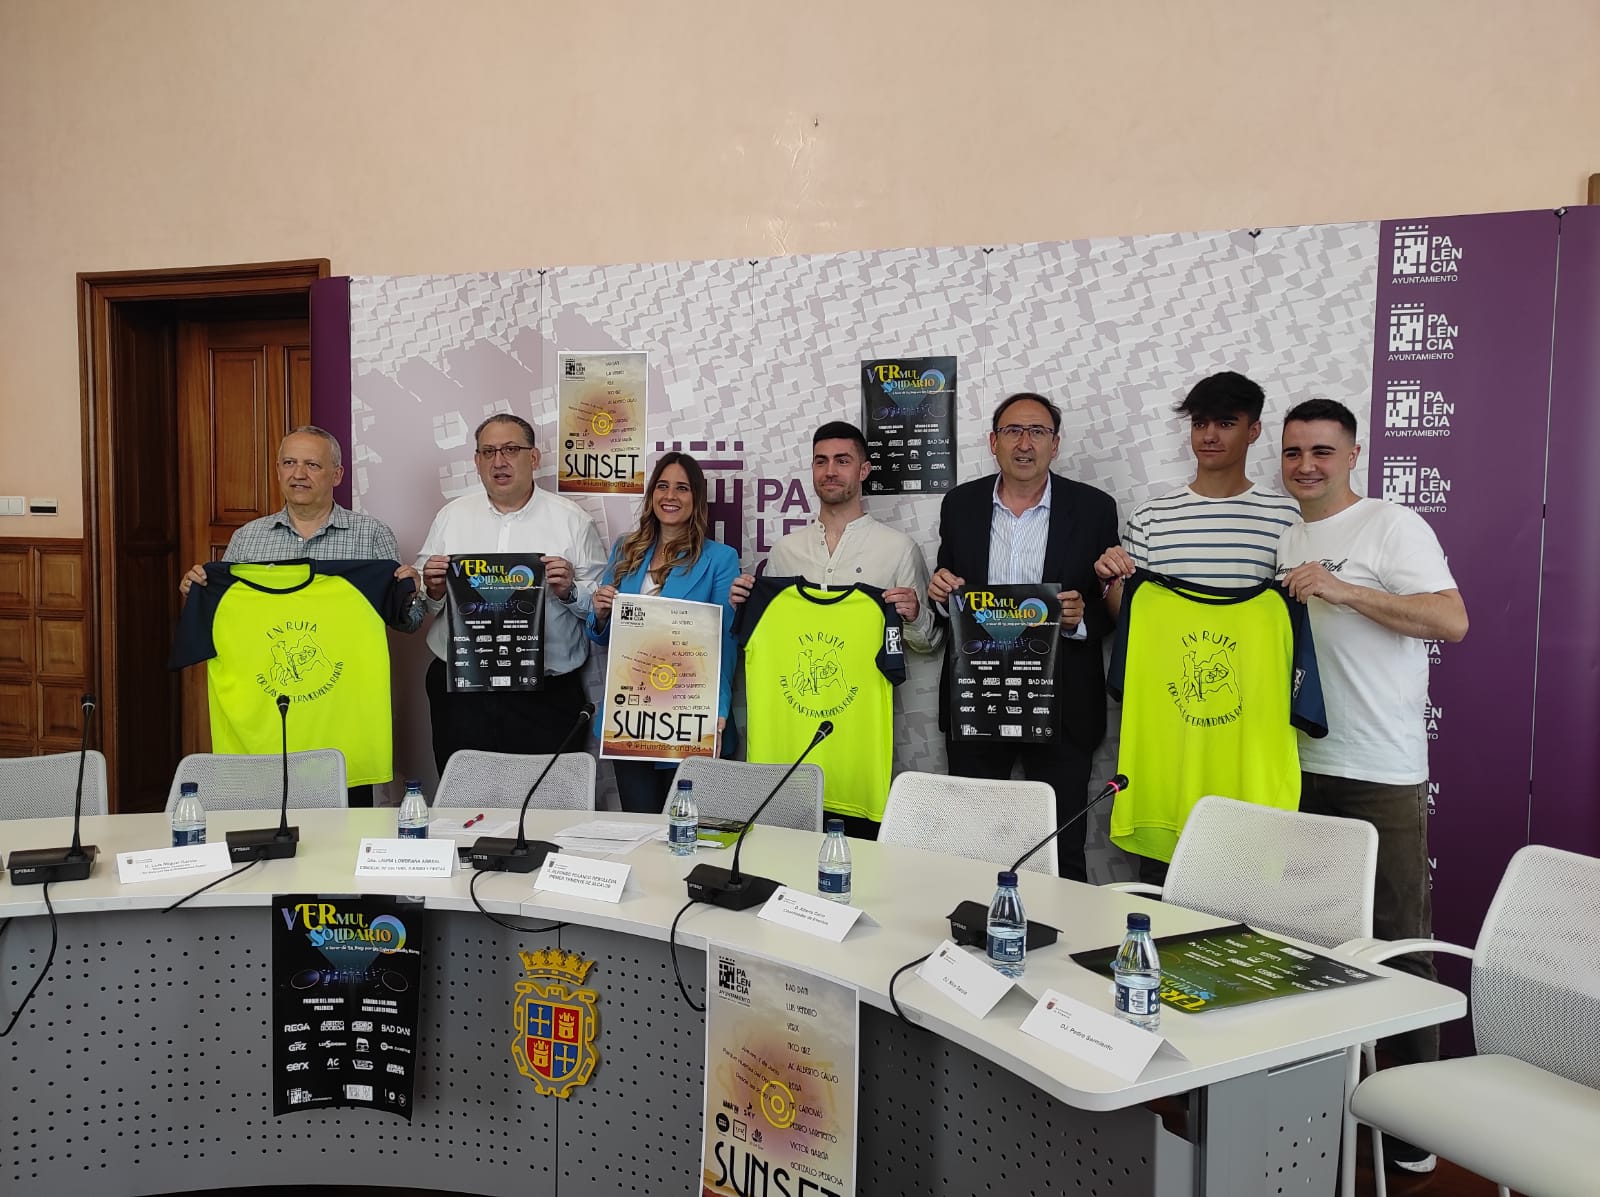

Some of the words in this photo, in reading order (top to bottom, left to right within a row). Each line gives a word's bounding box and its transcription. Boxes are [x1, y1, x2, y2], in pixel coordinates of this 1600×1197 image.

[1432, 236, 1452, 248] PA
[1432, 248, 1462, 260] LEN
[1430, 260, 1458, 272] CIA
[1392, 274, 1458, 284] AYUNTAMIENTO
[1428, 314, 1448, 326] PA
[1427, 326, 1458, 338] LEN
[1426, 338, 1454, 350] CIA
[1388, 352, 1454, 361] AYUNTAMIENTO
[881, 379, 936, 392] SOLIDARIO
[1424, 391, 1444, 403] PA
[1423, 403, 1455, 415] LEN
[1422, 416, 1450, 427] CIA
[1384, 429, 1450, 438] AYUNTAMIENTO
[565, 454, 639, 479] SUNSET
[1420, 468, 1440, 479] PA
[1420, 480, 1450, 492] LEN
[757, 479, 810, 513] PA
[1419, 492, 1446, 504] CIA
[468, 574, 524, 588] SOLIDARIO
[974, 608, 1037, 624] SOLIDARIO
[888, 629, 899, 640] E
[817, 632, 845, 650] RUTA
[1181, 632, 1198, 647] EN
[1202, 630, 1237, 652] RUTA
[613, 710, 708, 742] SUNSET
[308, 928, 392, 946] SOLIDARIO
[737, 968, 746, 978] PA
[737, 976, 750, 987] LEN
[737, 985, 749, 995] CIA
[284, 1023, 311, 1033] REGA
[381, 1024, 395, 1033] BAD
[1070, 1028, 1085, 1039] Pedro
[1086, 1034, 1114, 1050] Sarmiento
[327, 1058, 339, 1067] AC
[821, 1072, 839, 1084] CALVO
